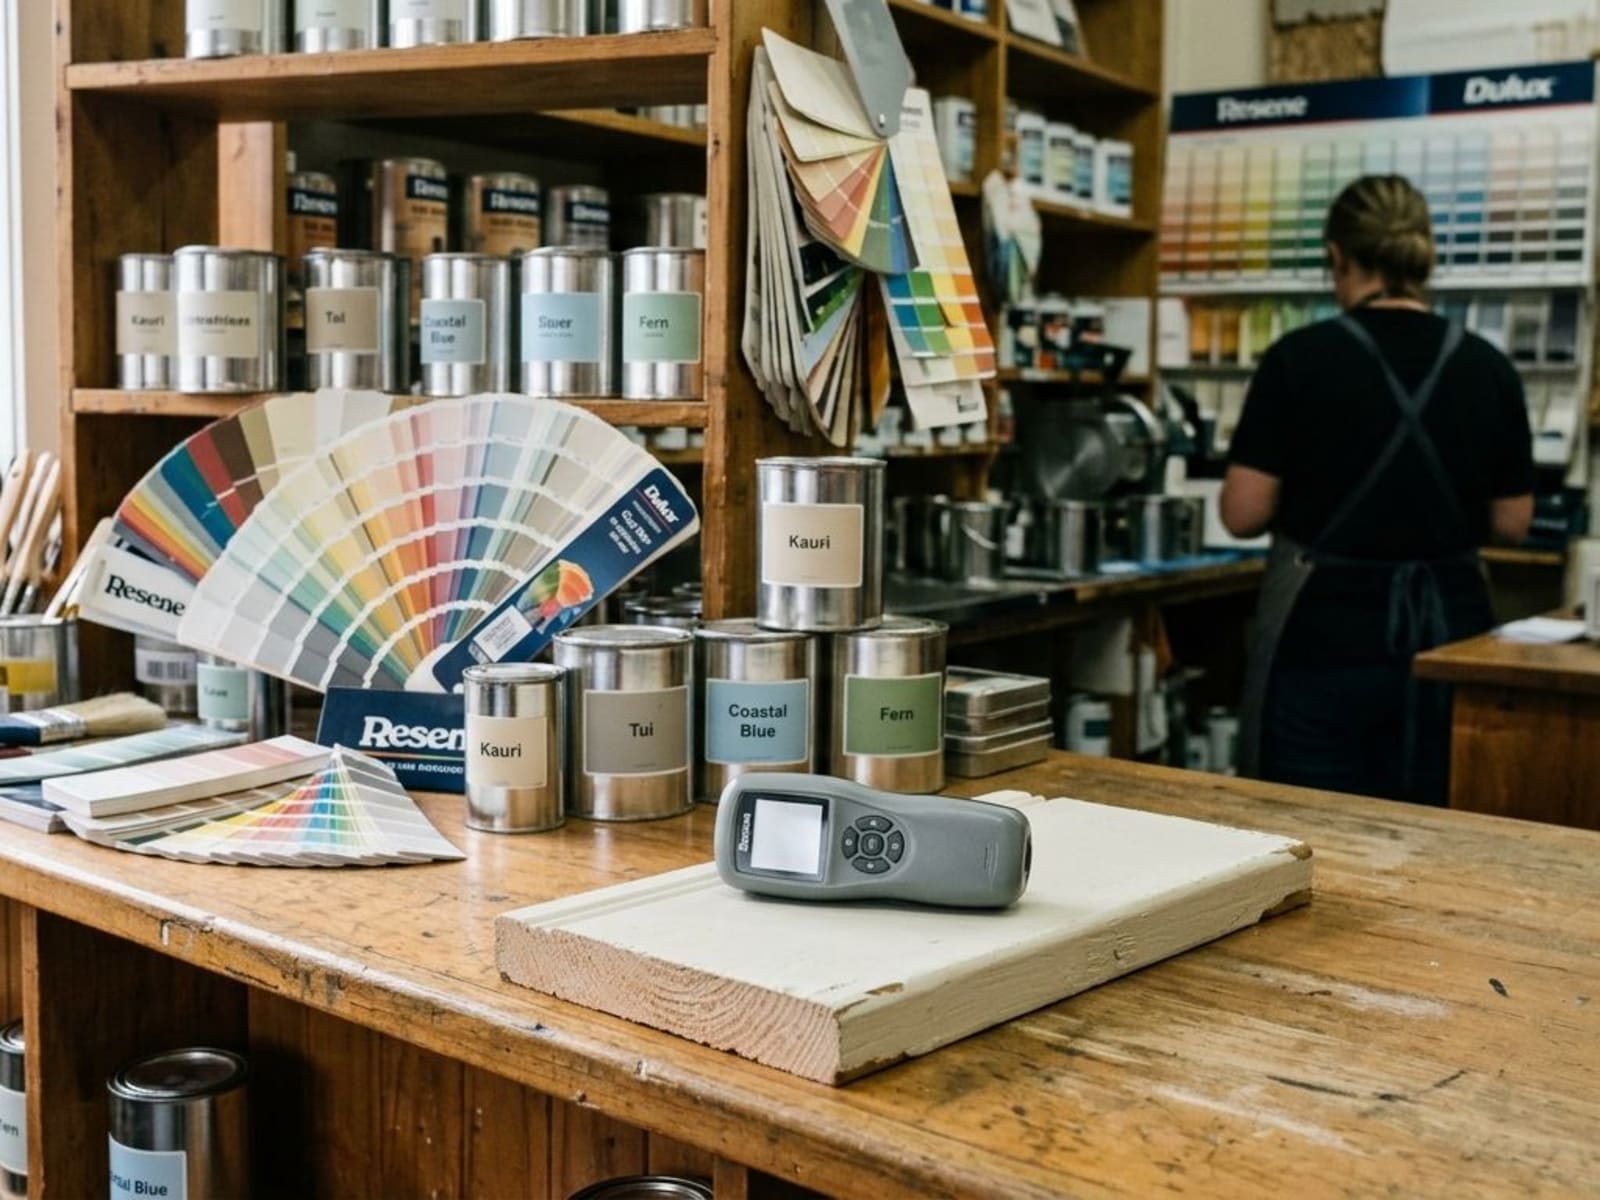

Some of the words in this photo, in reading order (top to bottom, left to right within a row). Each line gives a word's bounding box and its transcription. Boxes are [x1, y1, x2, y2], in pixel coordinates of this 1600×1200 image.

[1463, 75, 1556, 104] Dulux
[639, 315, 670, 330] Fern
[104, 573, 186, 616] Resene
[728, 703, 788, 719] Coastal
[880, 707, 914, 721] Fern
[628, 722, 654, 738] Tui
[740, 723, 776, 738] Blue
[480, 741, 522, 758] Kauri
